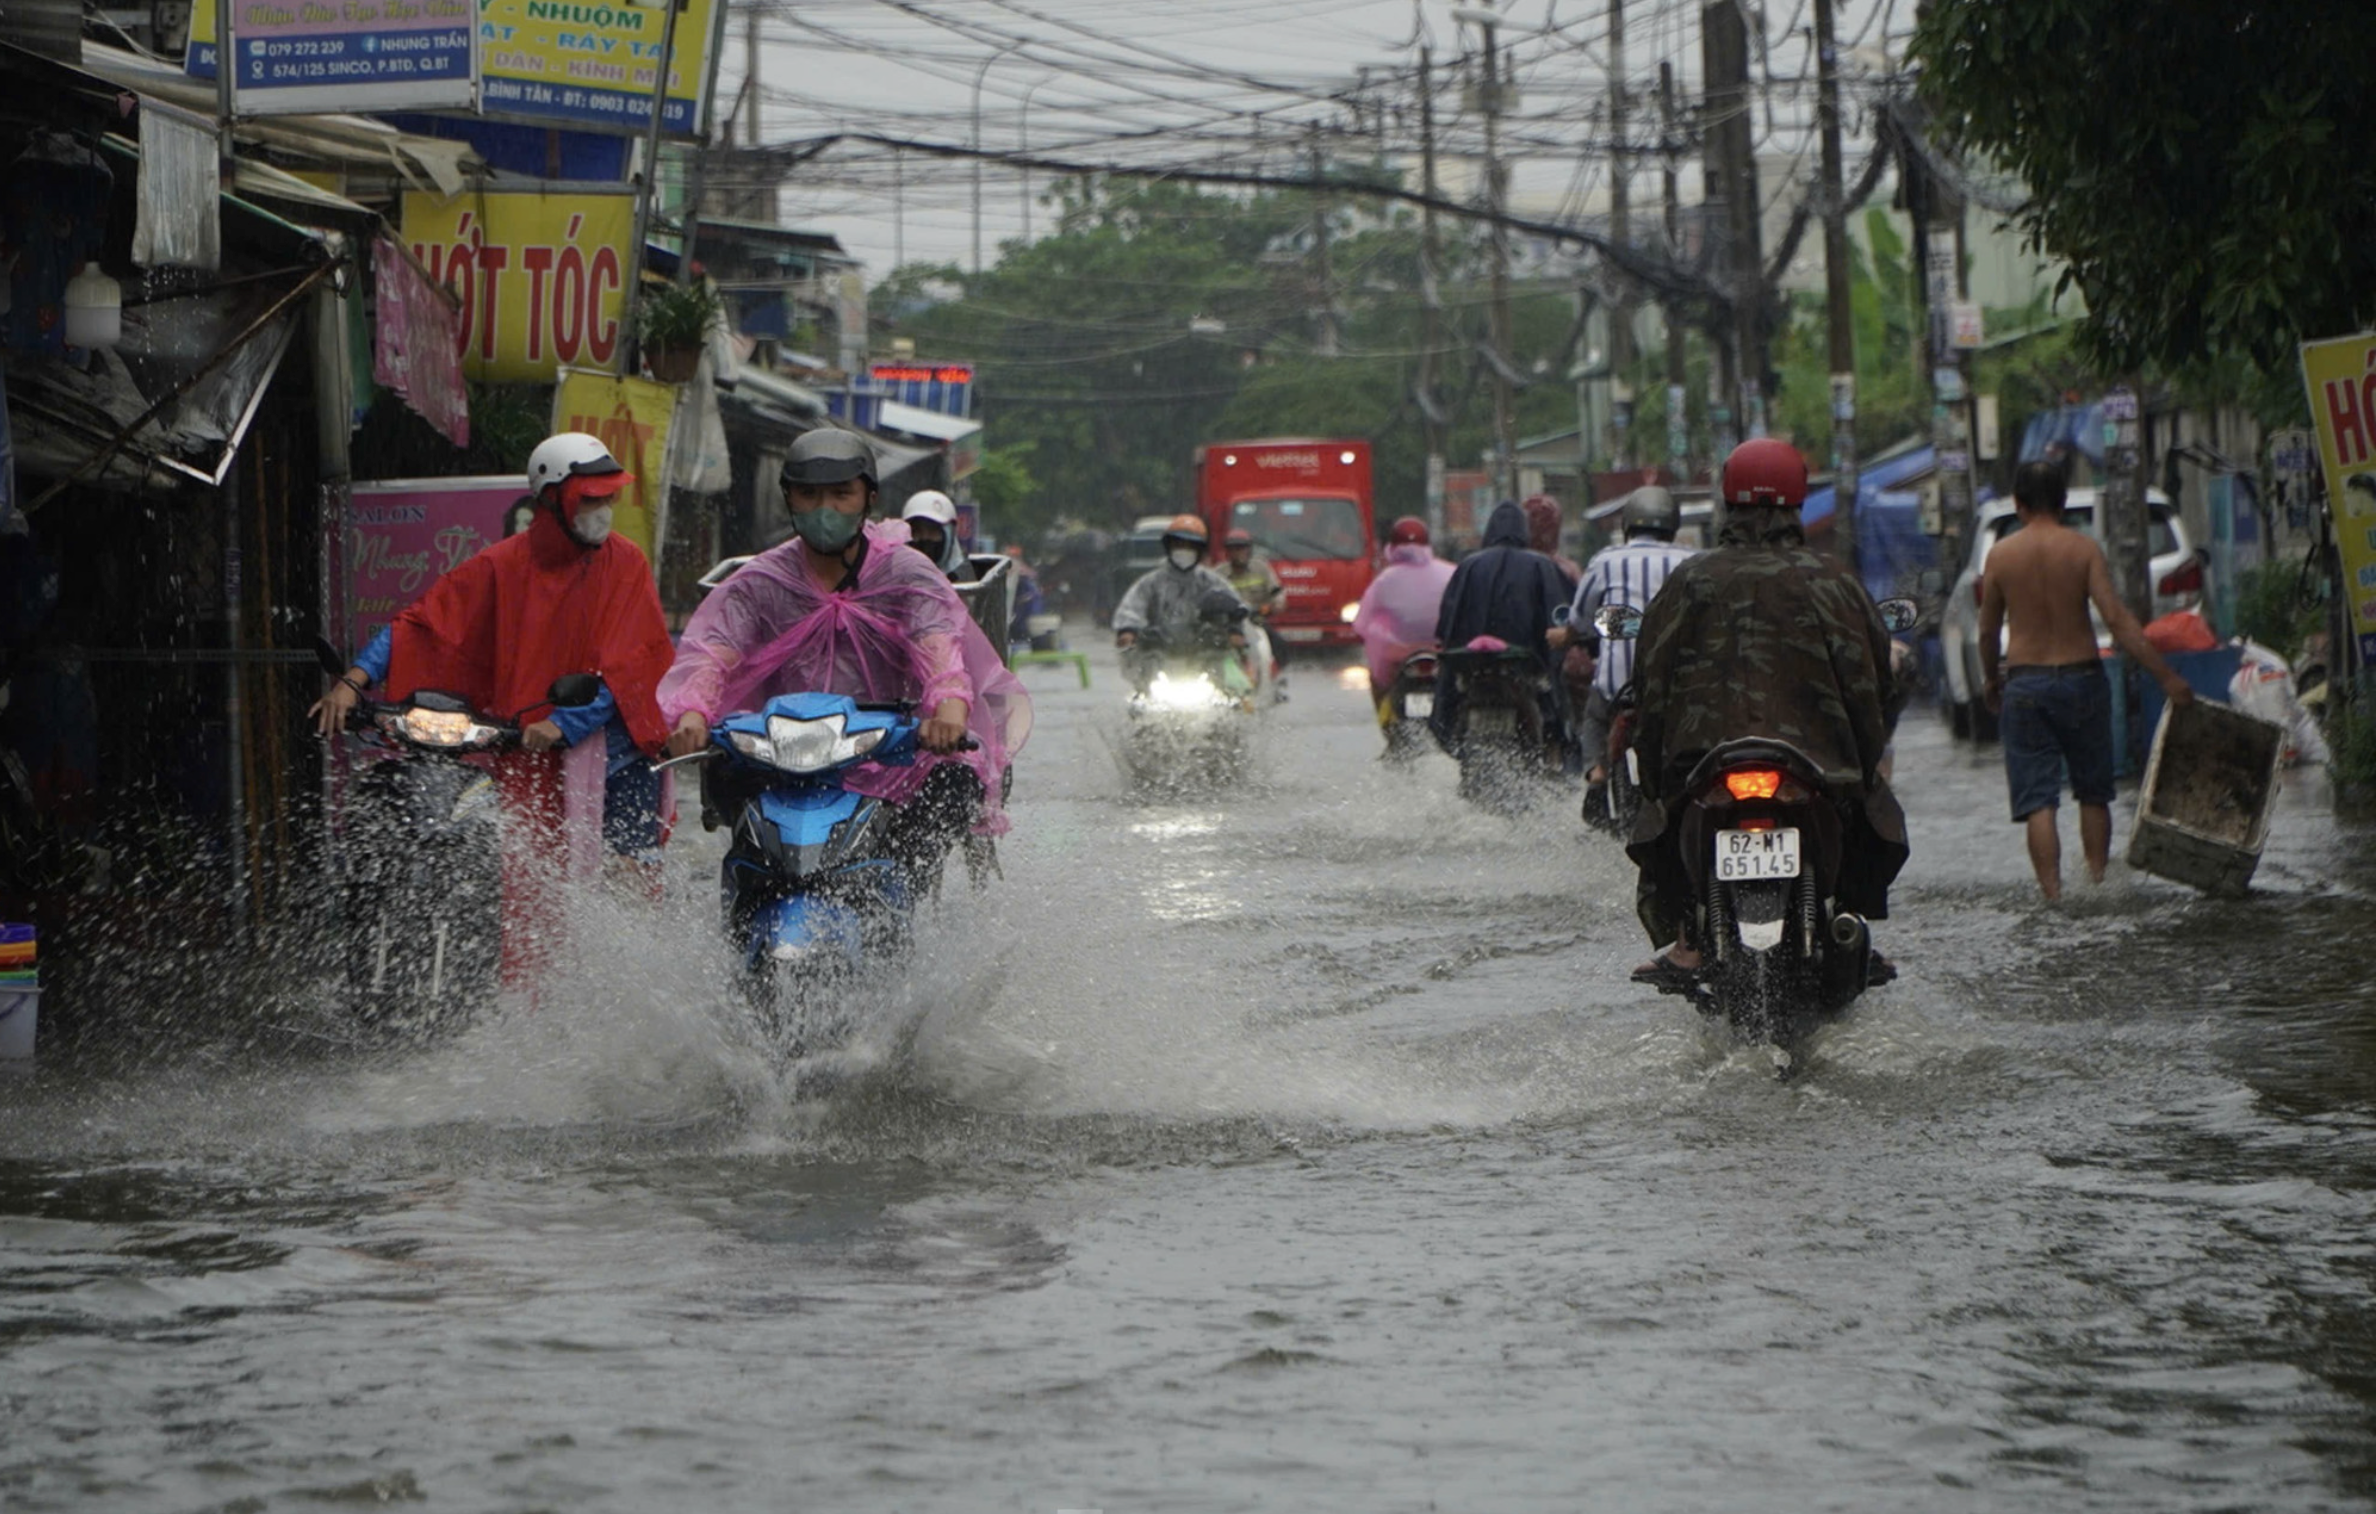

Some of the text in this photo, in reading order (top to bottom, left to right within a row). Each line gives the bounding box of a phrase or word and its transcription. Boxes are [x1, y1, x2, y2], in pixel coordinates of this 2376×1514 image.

[527, 1, 644, 30] NHUỘM
[268, 41, 345, 57] 079 272 239
[381, 36, 430, 52] NHUNG
[273, 61, 325, 78] 574/125
[495, 51, 544, 71] DÂN
[568, 59, 626, 80] KÍNH
[634, 68, 680, 88] MI
[525, 85, 553, 104] TÂN
[413, 212, 620, 364] ỚT TÓC
[350, 504, 425, 524] SALON
[1722, 854, 1795, 877] 651.45
